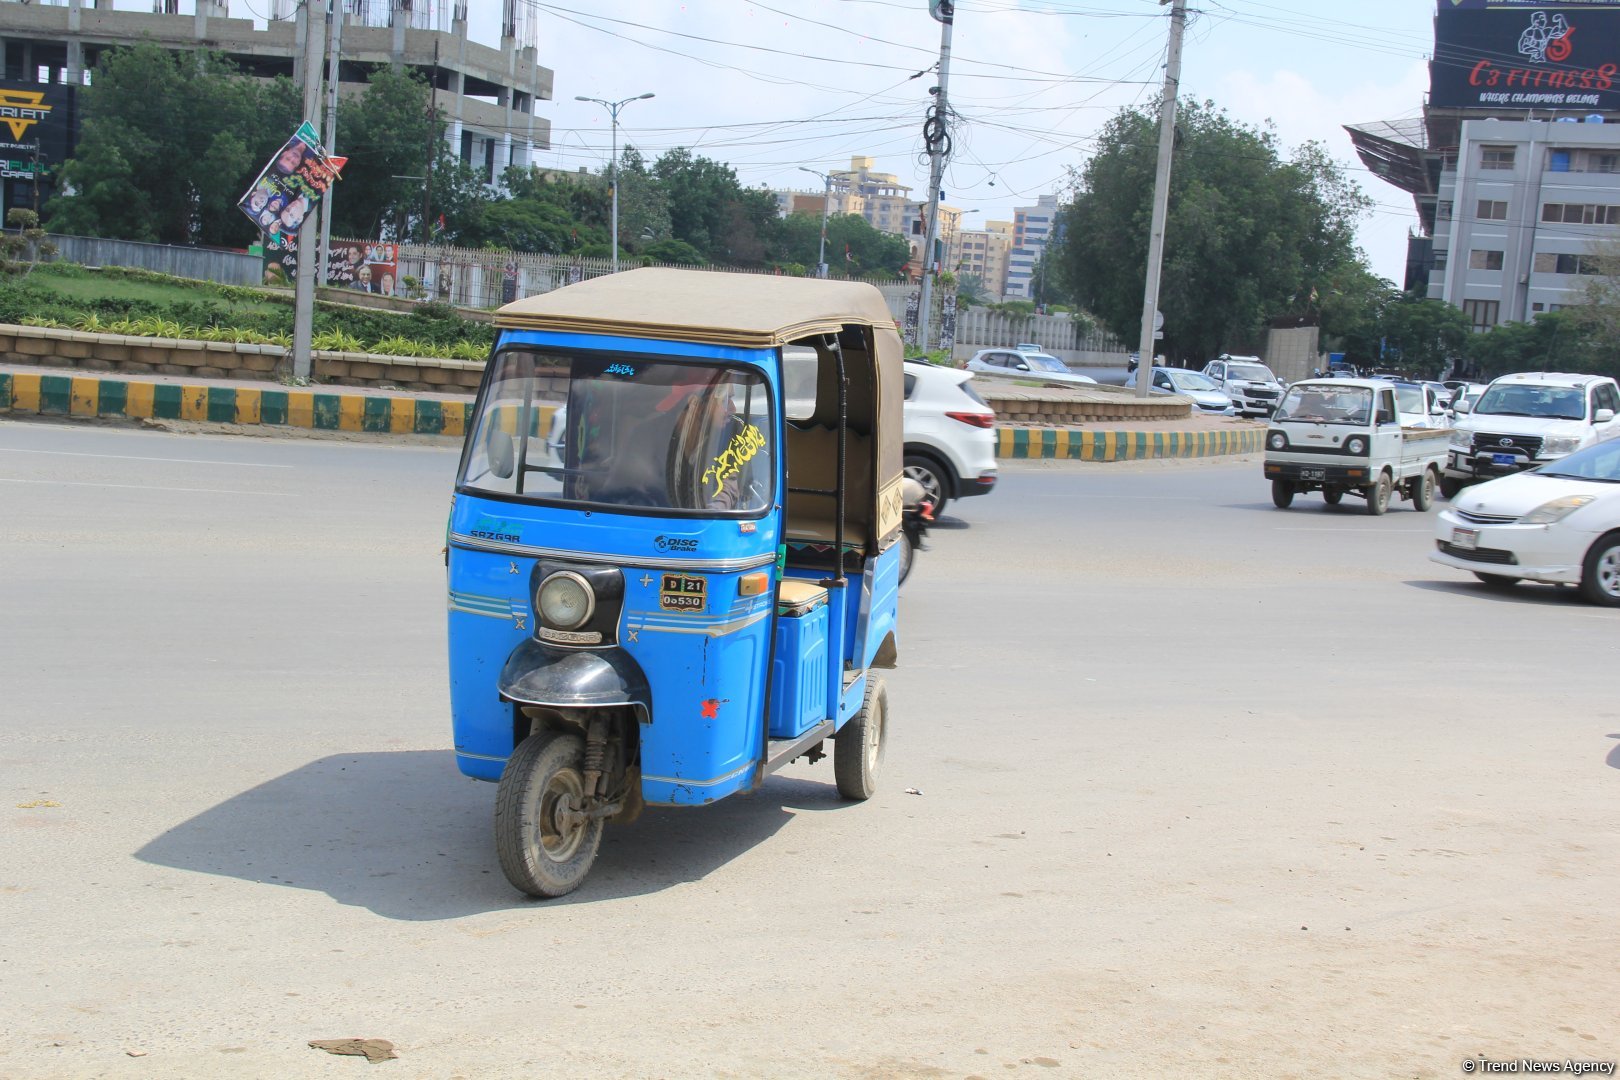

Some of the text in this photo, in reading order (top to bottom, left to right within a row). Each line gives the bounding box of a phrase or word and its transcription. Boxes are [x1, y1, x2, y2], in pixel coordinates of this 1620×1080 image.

[1469, 60, 1617, 90] C3 FITNESS
[1479, 92, 1510, 104] WHERE
[1, 170, 34, 180] CAFE
[667, 538, 698, 547] DISC
[670, 580, 677, 589] D
[687, 582, 701, 591] 21
